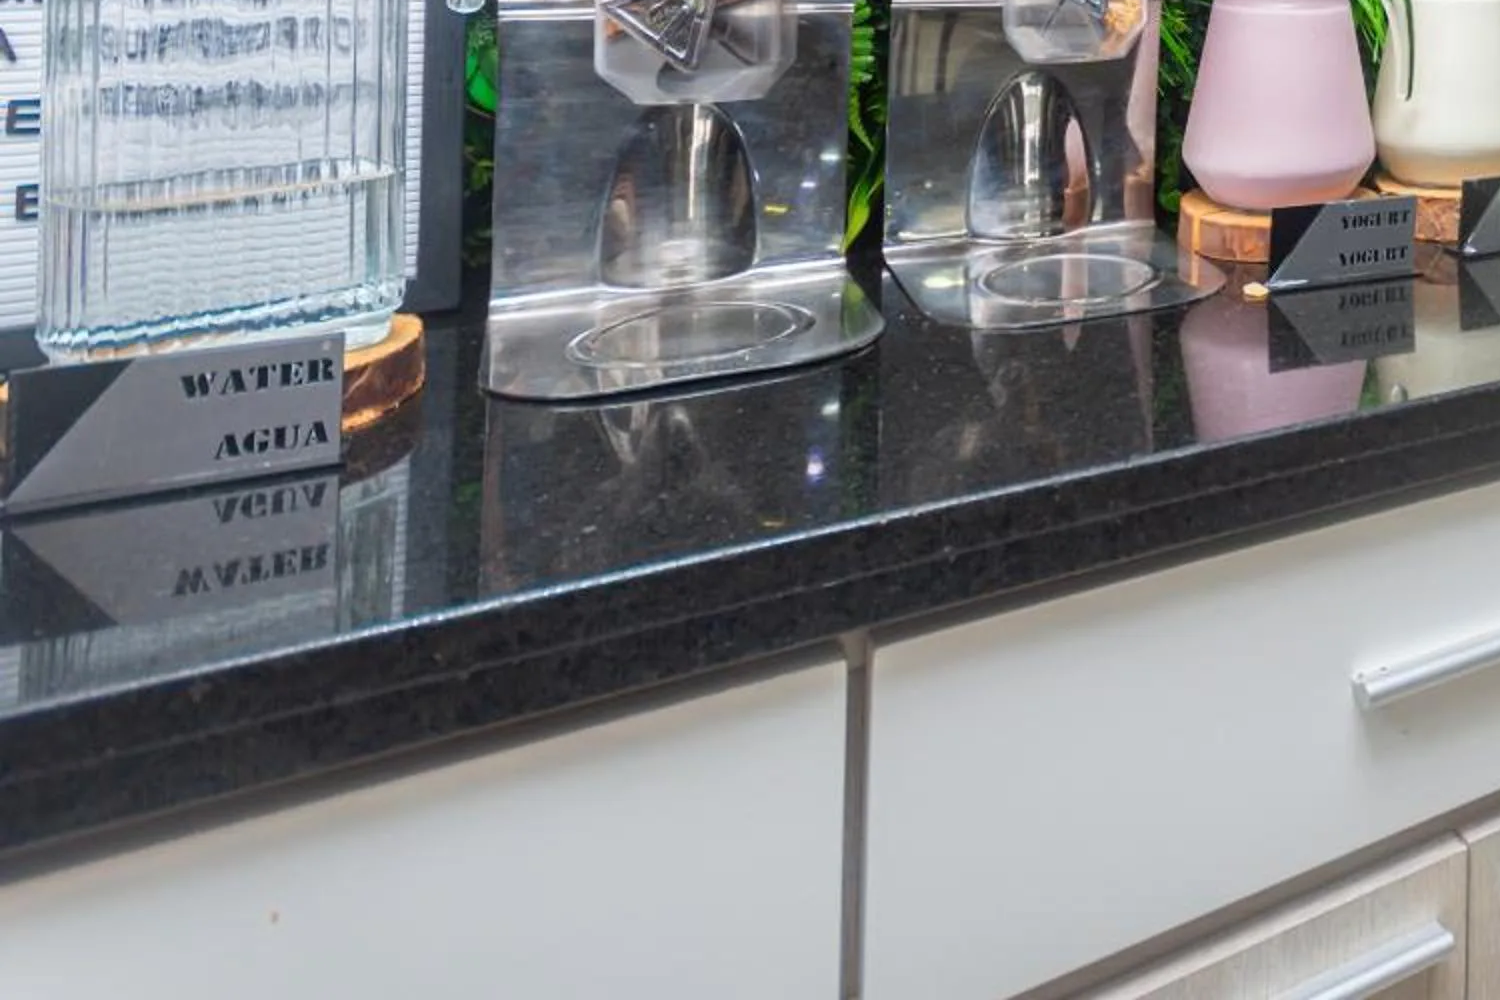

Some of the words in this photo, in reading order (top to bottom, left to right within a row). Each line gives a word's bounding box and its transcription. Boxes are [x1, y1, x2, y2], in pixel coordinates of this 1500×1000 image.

[1342, 209, 1411, 229] YOGURT
[1339, 245, 1409, 267] YOGURT
[180, 357, 334, 399] WATER
[213, 420, 329, 460] AGUA
